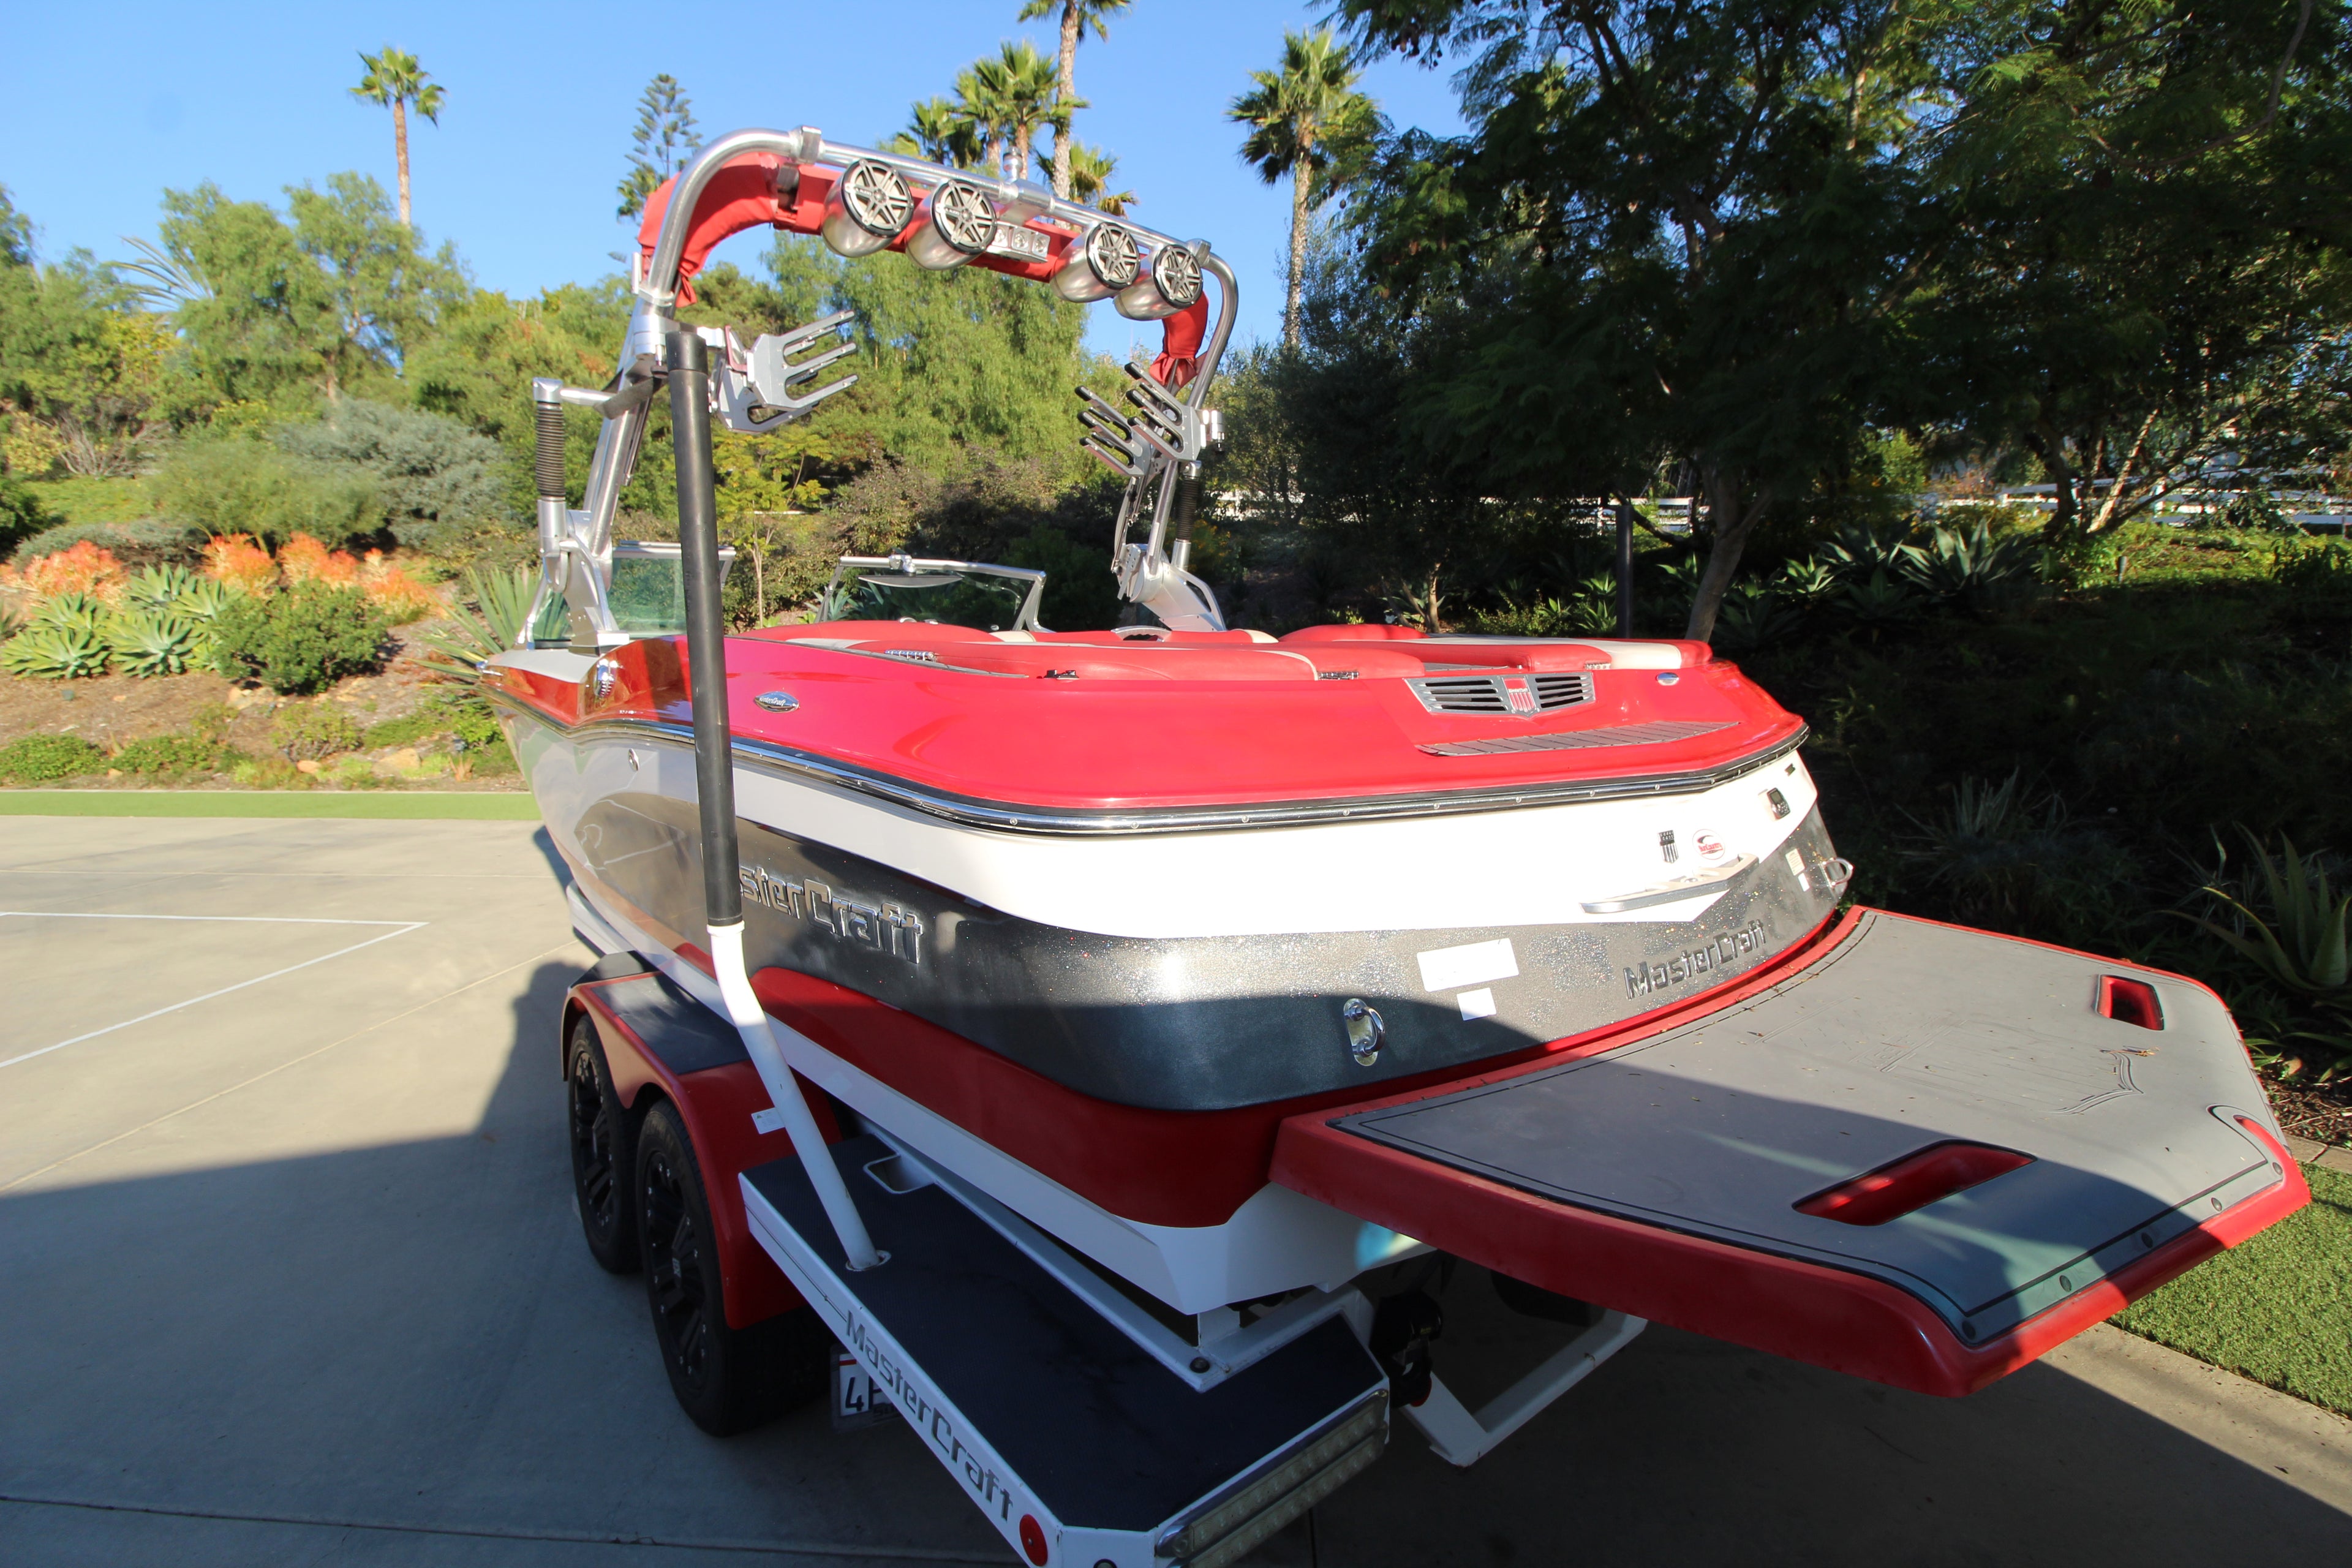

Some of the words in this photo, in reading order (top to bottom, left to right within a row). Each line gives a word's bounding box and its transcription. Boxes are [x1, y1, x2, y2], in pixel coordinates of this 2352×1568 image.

[739, 865, 923, 964] sterCraft
[1623, 919, 1766, 1000] MasterCraft
[846, 1311, 1014, 1522] MasterCraft
